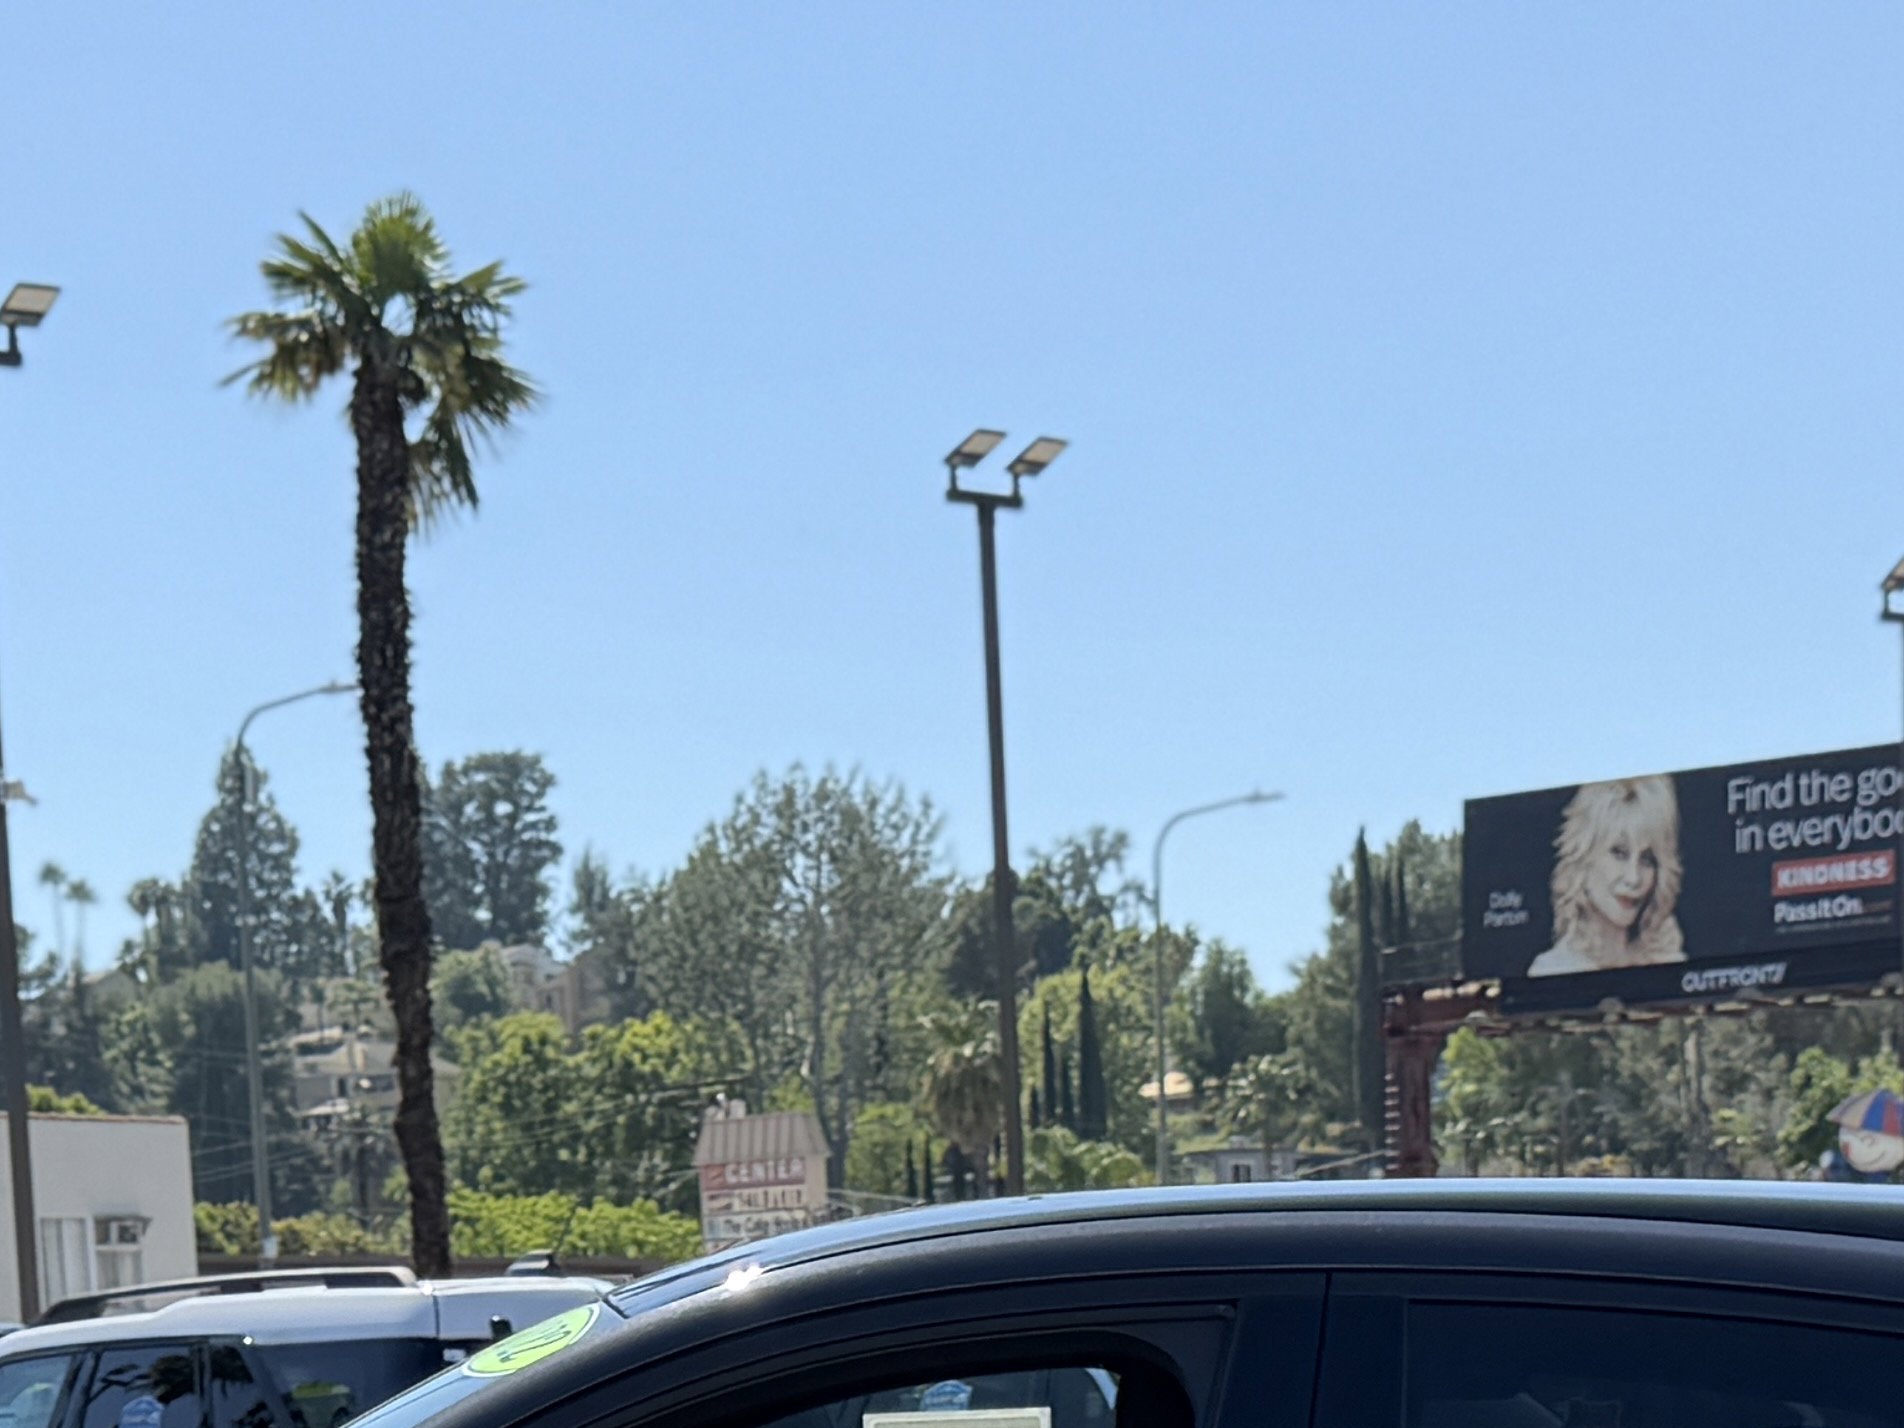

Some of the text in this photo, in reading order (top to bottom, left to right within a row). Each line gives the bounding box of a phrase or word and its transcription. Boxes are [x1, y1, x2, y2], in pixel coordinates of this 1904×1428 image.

[1727, 772, 1795, 816] Find
[1799, 767, 1854, 807] the
[1735, 818, 1764, 853] in
[1777, 857, 1890, 889] KINDNESS
